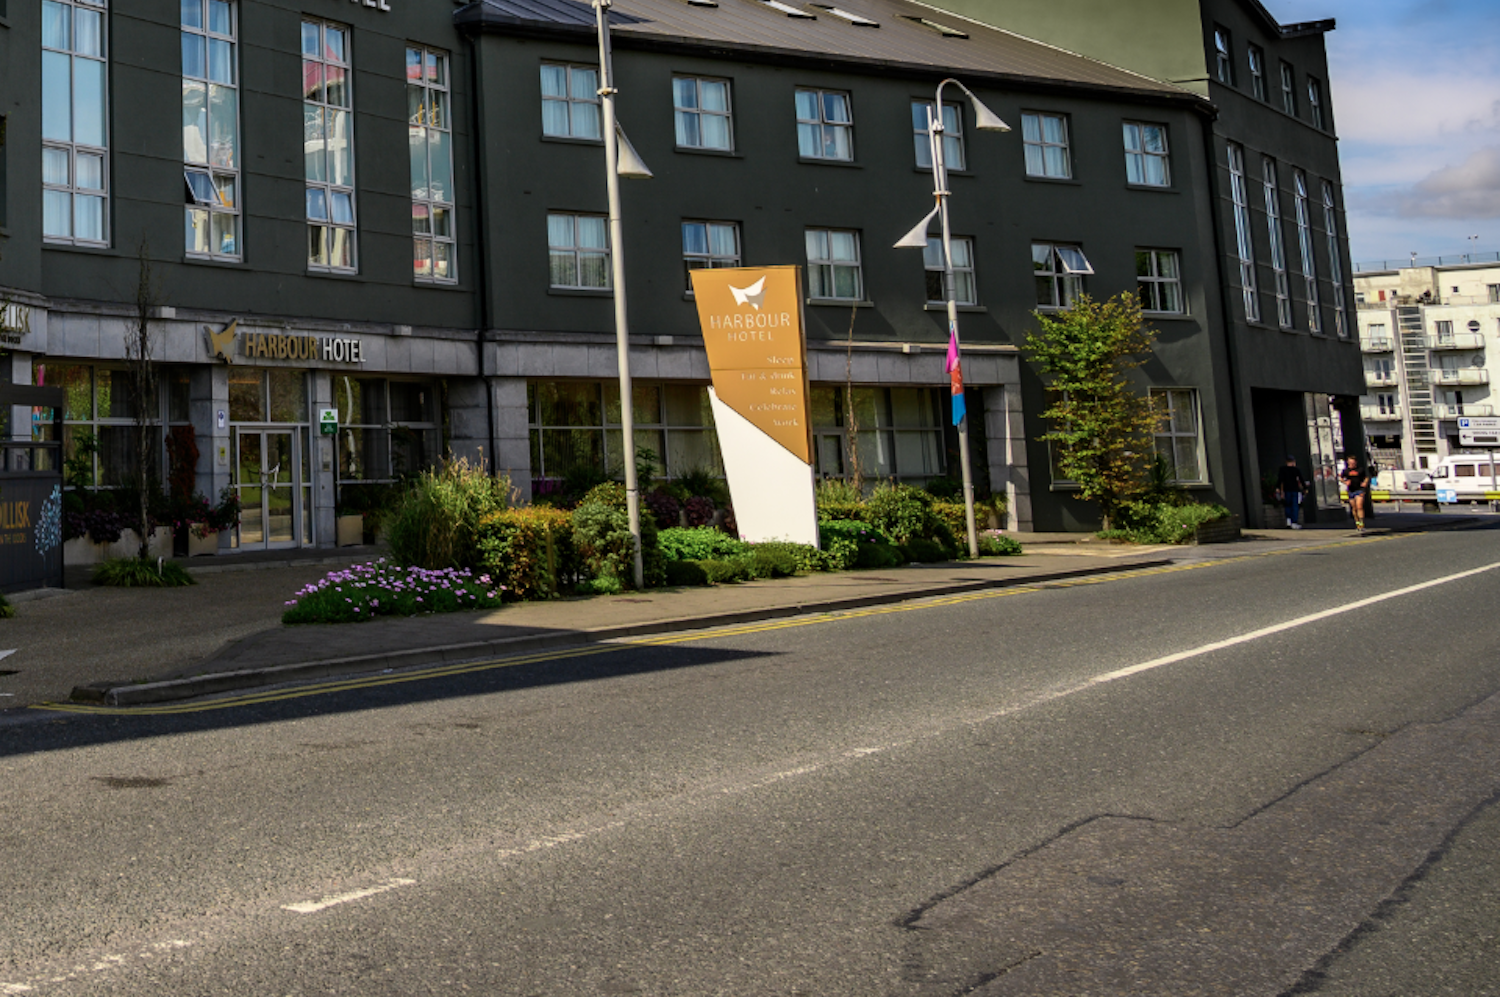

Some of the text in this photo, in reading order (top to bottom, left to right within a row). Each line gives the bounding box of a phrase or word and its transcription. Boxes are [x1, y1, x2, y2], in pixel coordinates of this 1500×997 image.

[710, 312, 790, 329] HARBOUR
[727, 331, 773, 341] HOTEL
[245, 333, 366, 362] HARBOUR HOTEL
[766, 356, 794, 364] Sleep
[769, 387, 796, 395] Relax
[749, 402, 797, 411] Celebrate
[1446, 490, 1456, 501] P
